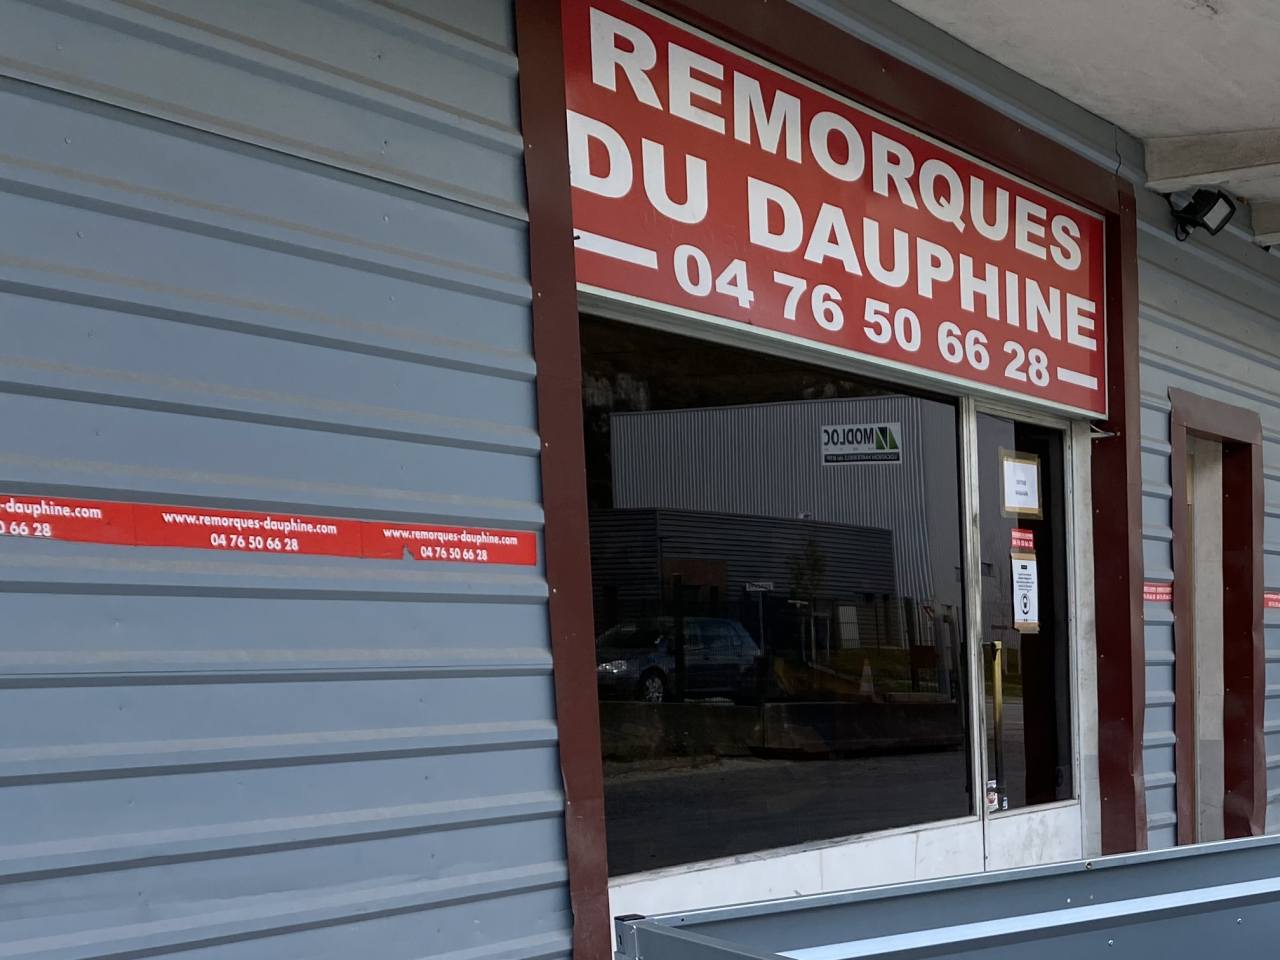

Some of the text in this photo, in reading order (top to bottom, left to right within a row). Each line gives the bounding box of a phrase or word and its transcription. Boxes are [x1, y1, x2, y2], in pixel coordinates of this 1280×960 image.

[589, 6, 1082, 271] REMORQUES
[566, 109, 1097, 351] DU DAUPHINE
[673, 243, 1050, 387] 04 76 50 66 28
[9, 522, 29, 535] 66
[32, 522, 52, 537] 28
[162, 512, 337, 535] www.remorques-dauphine.com
[210, 533, 299, 551] 04 76 50 66 28
[383, 528, 518, 546] www.remorques-dauphine.com
[420, 546, 488, 561] 04 76 50 66 28
